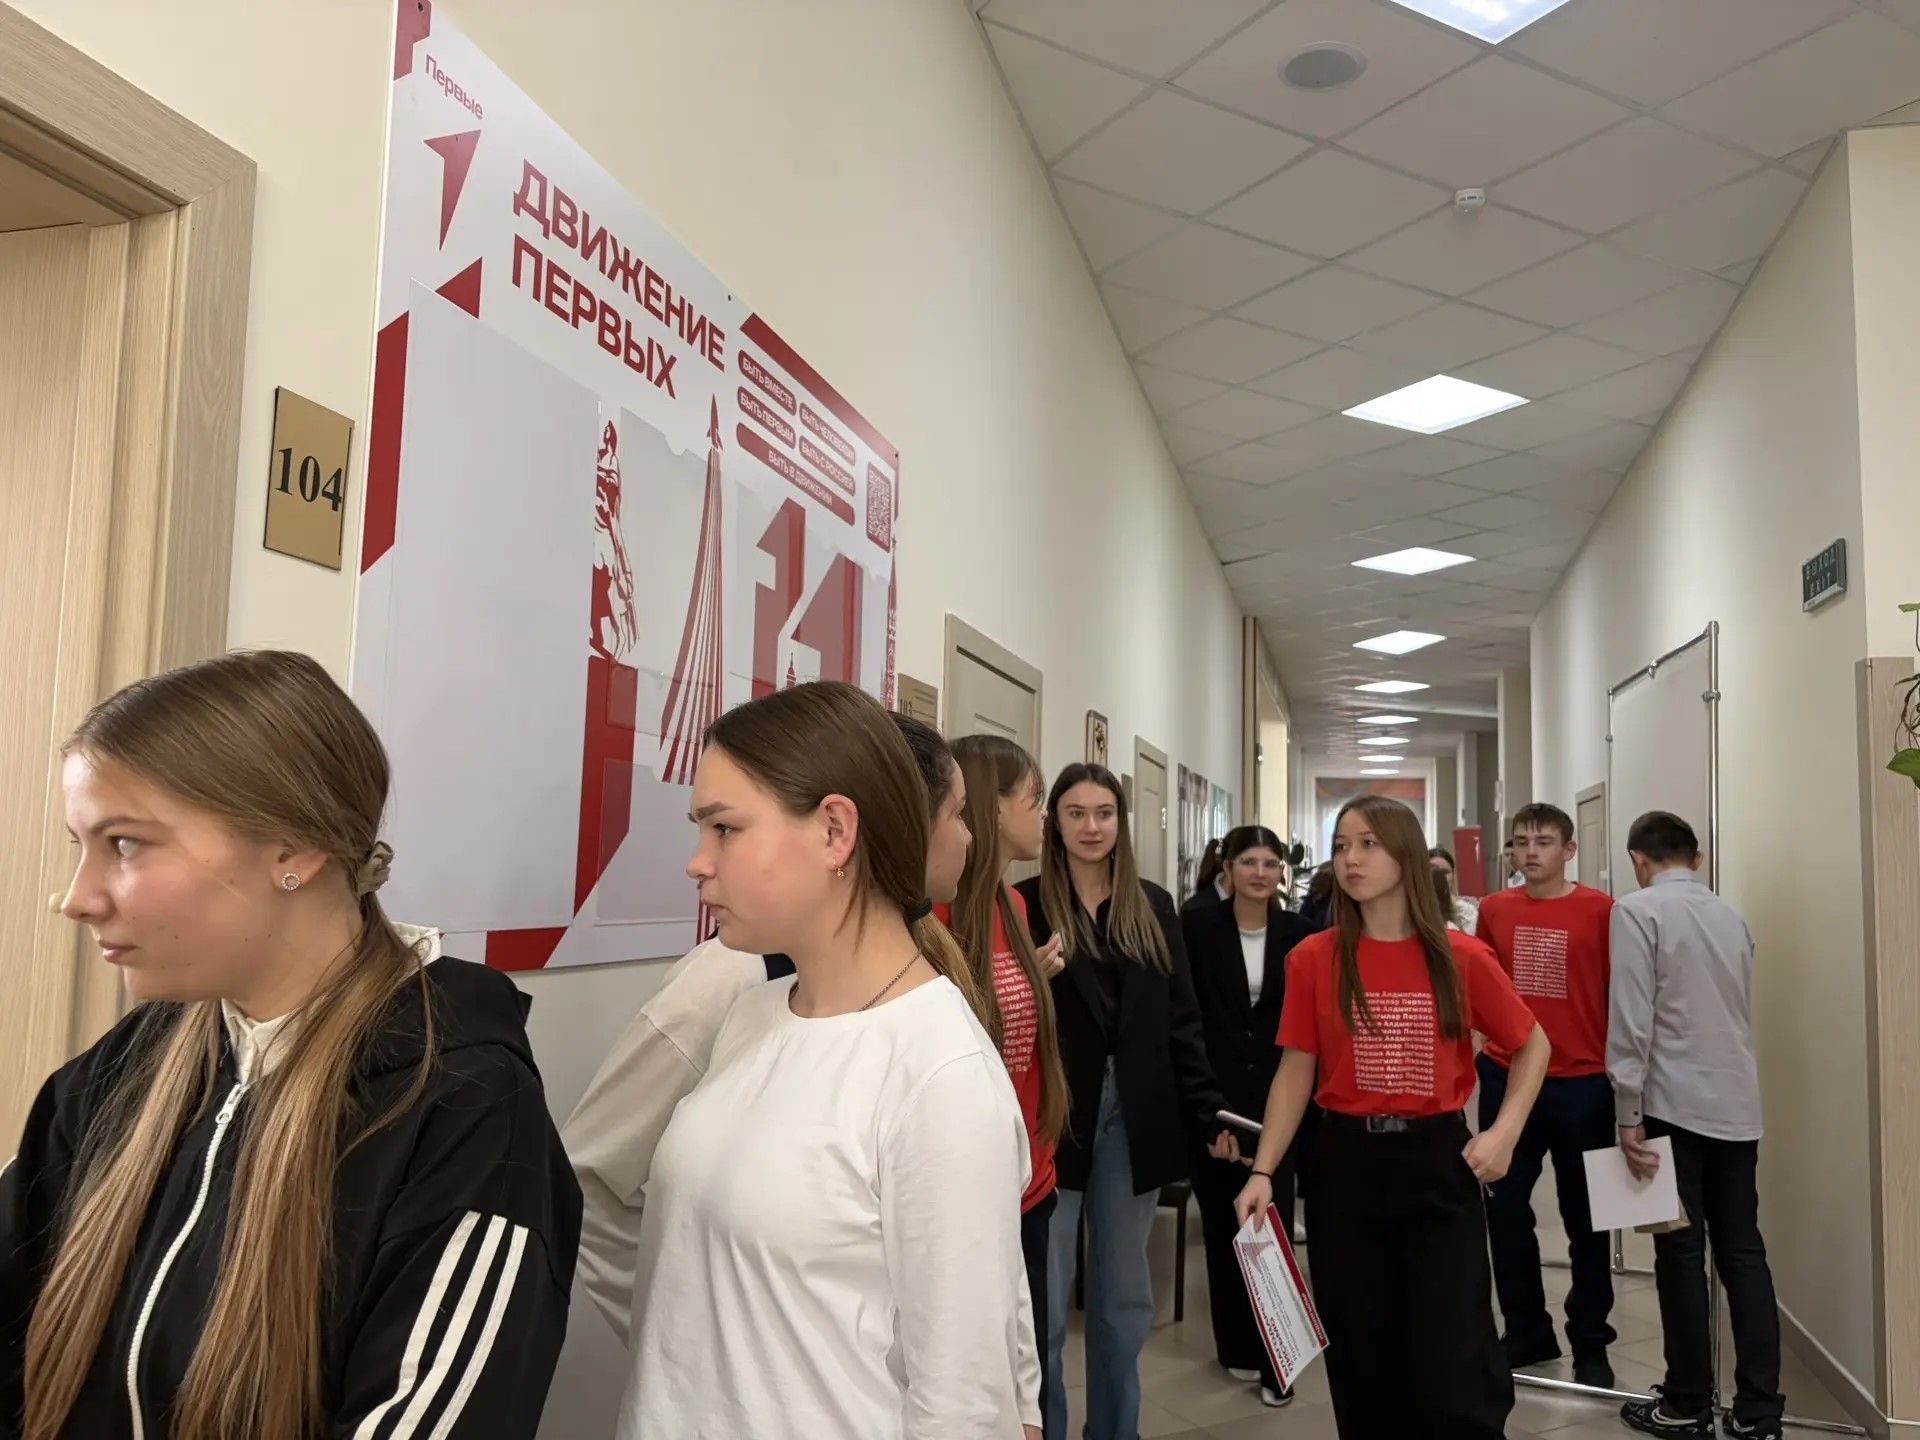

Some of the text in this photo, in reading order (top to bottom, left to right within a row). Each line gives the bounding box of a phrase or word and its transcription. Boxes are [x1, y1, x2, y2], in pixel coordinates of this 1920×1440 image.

[425, 53, 484, 120] Первые
[513, 158, 726, 373] ДВИЖЕНИЕ
[511, 232, 678, 400] ПЕРВЫХ
[743, 357, 794, 410] БЫТЬ ВМЕСТЕ
[740, 392, 794, 444] БЫТЬ ПЕРВЫМ
[274, 447, 343, 513] 104
[768, 450, 789, 474] БЫТЬ
[1806, 546, 1836, 580] ВЫХОД
[1810, 572, 1832, 597] EXIT
